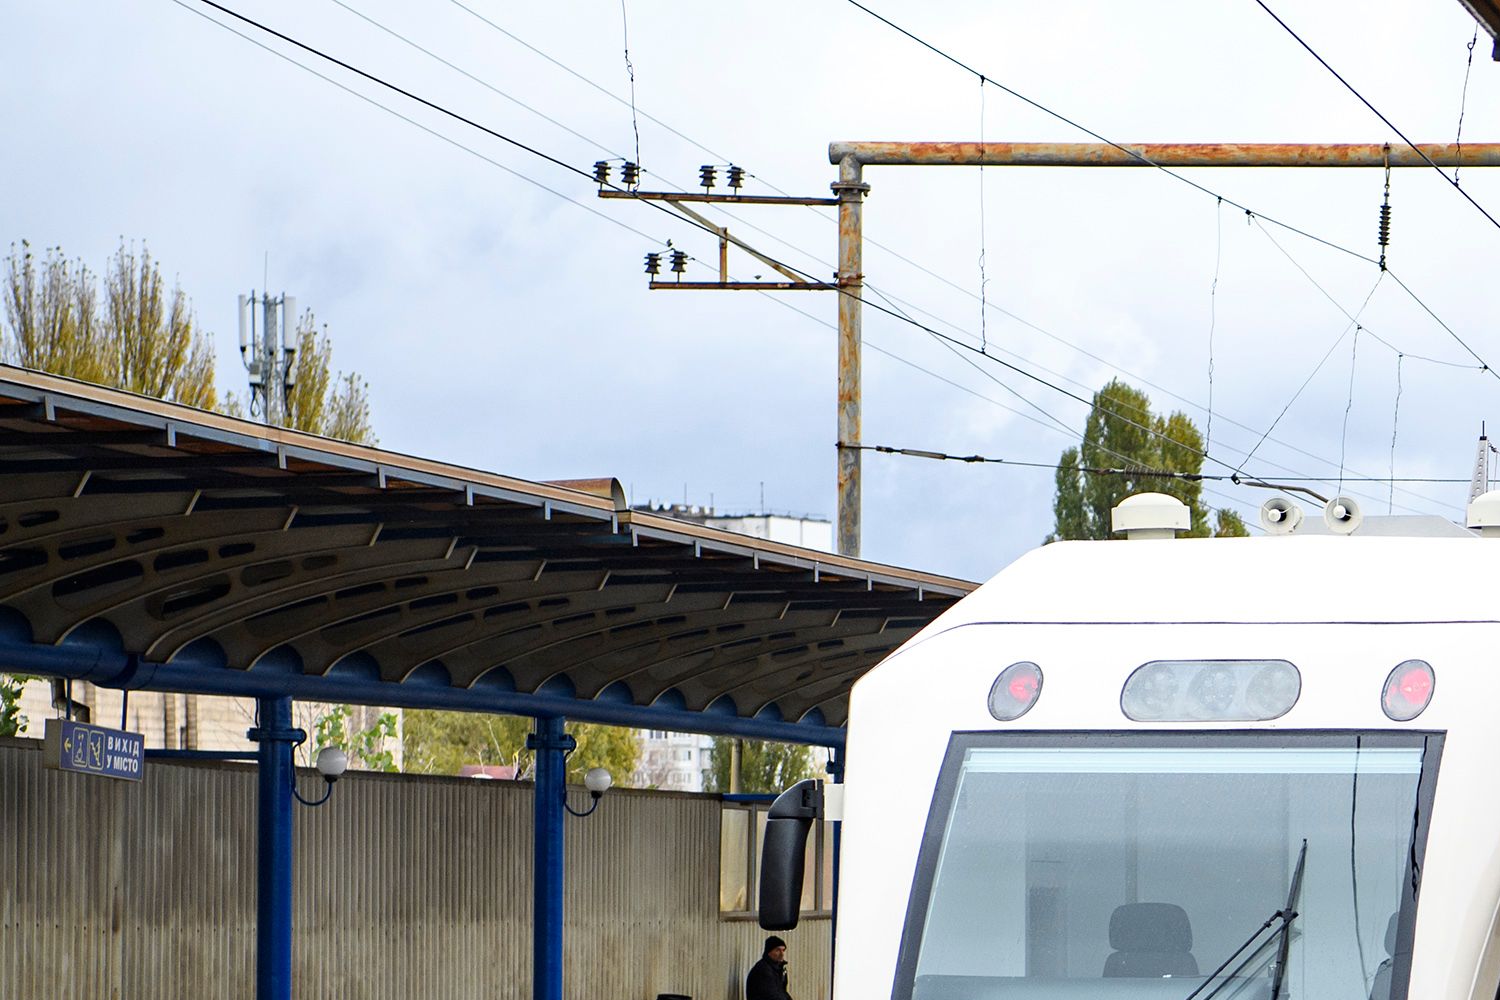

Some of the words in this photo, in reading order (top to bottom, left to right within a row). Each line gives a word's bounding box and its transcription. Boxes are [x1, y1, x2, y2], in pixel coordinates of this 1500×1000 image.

[108, 736, 139, 758] ВИХІД
[106, 754, 112, 769] У
[113, 755, 139, 773] МІСТО
